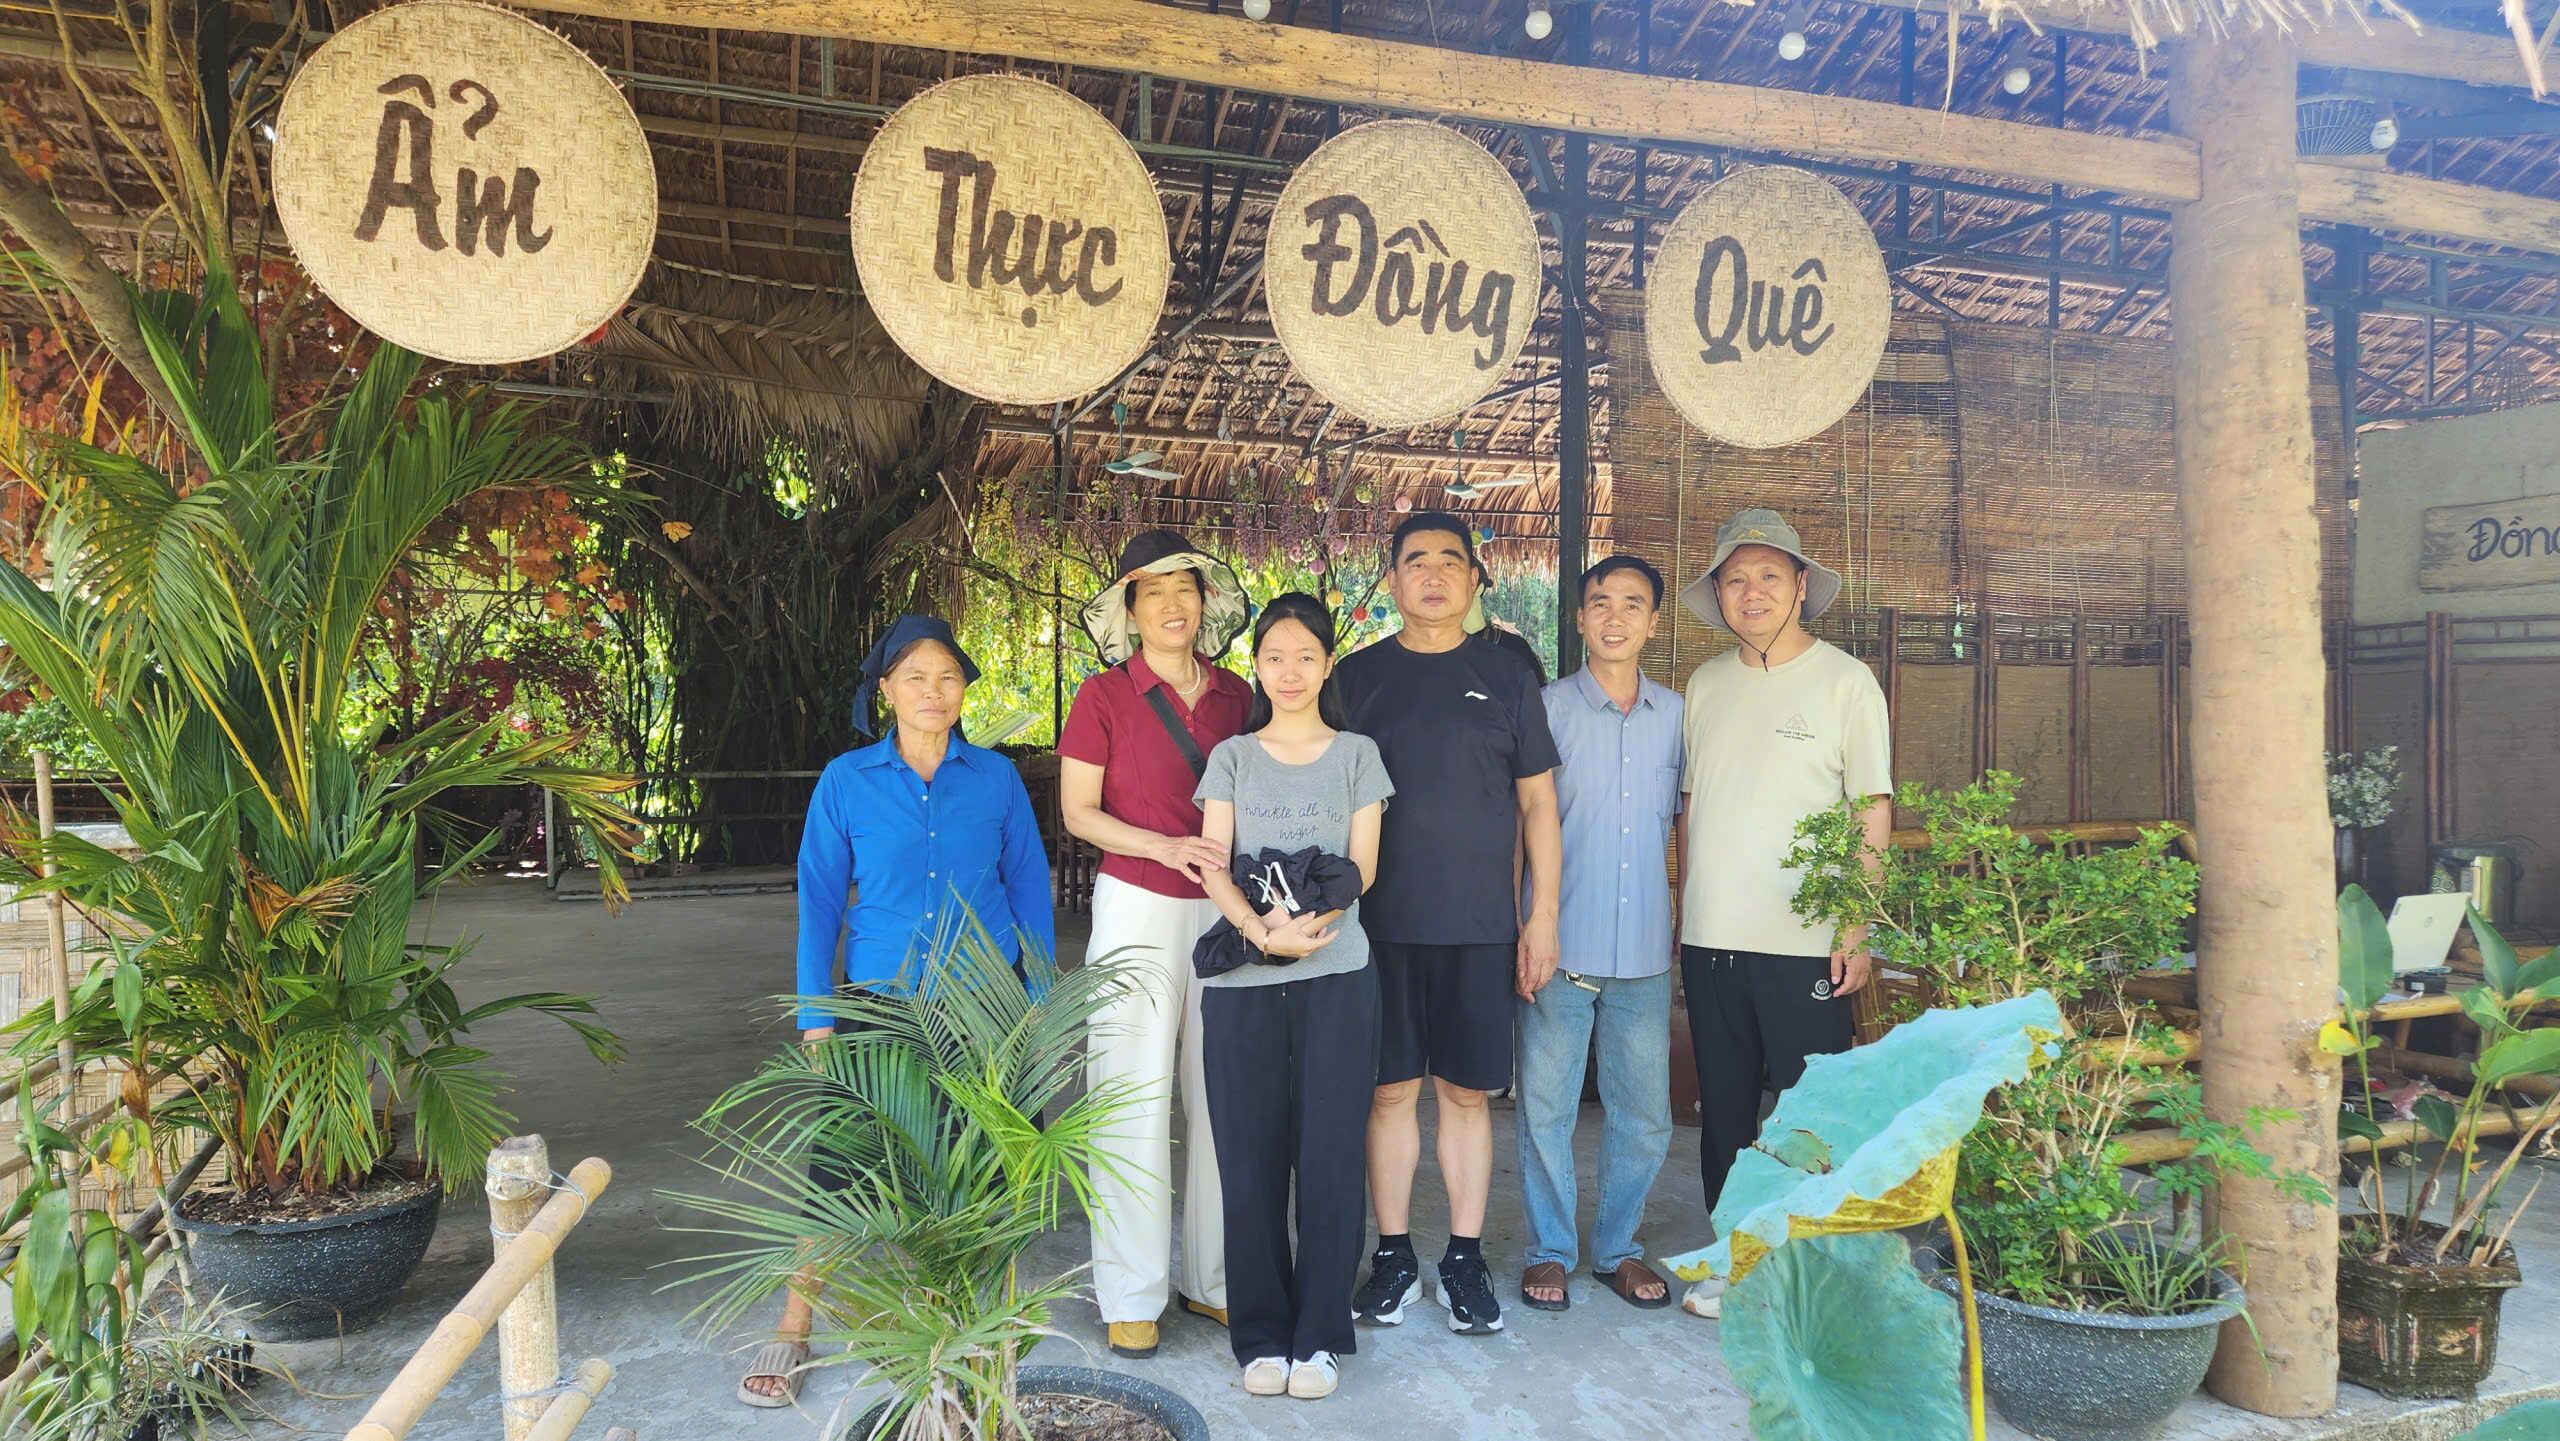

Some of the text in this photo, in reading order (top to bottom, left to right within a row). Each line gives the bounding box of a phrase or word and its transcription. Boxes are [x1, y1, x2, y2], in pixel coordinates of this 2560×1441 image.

[354, 74, 1835, 371] Ẩm Thực Đồng Quê
[1298, 802, 1319, 819] all
[1323, 806, 1345, 825] the
